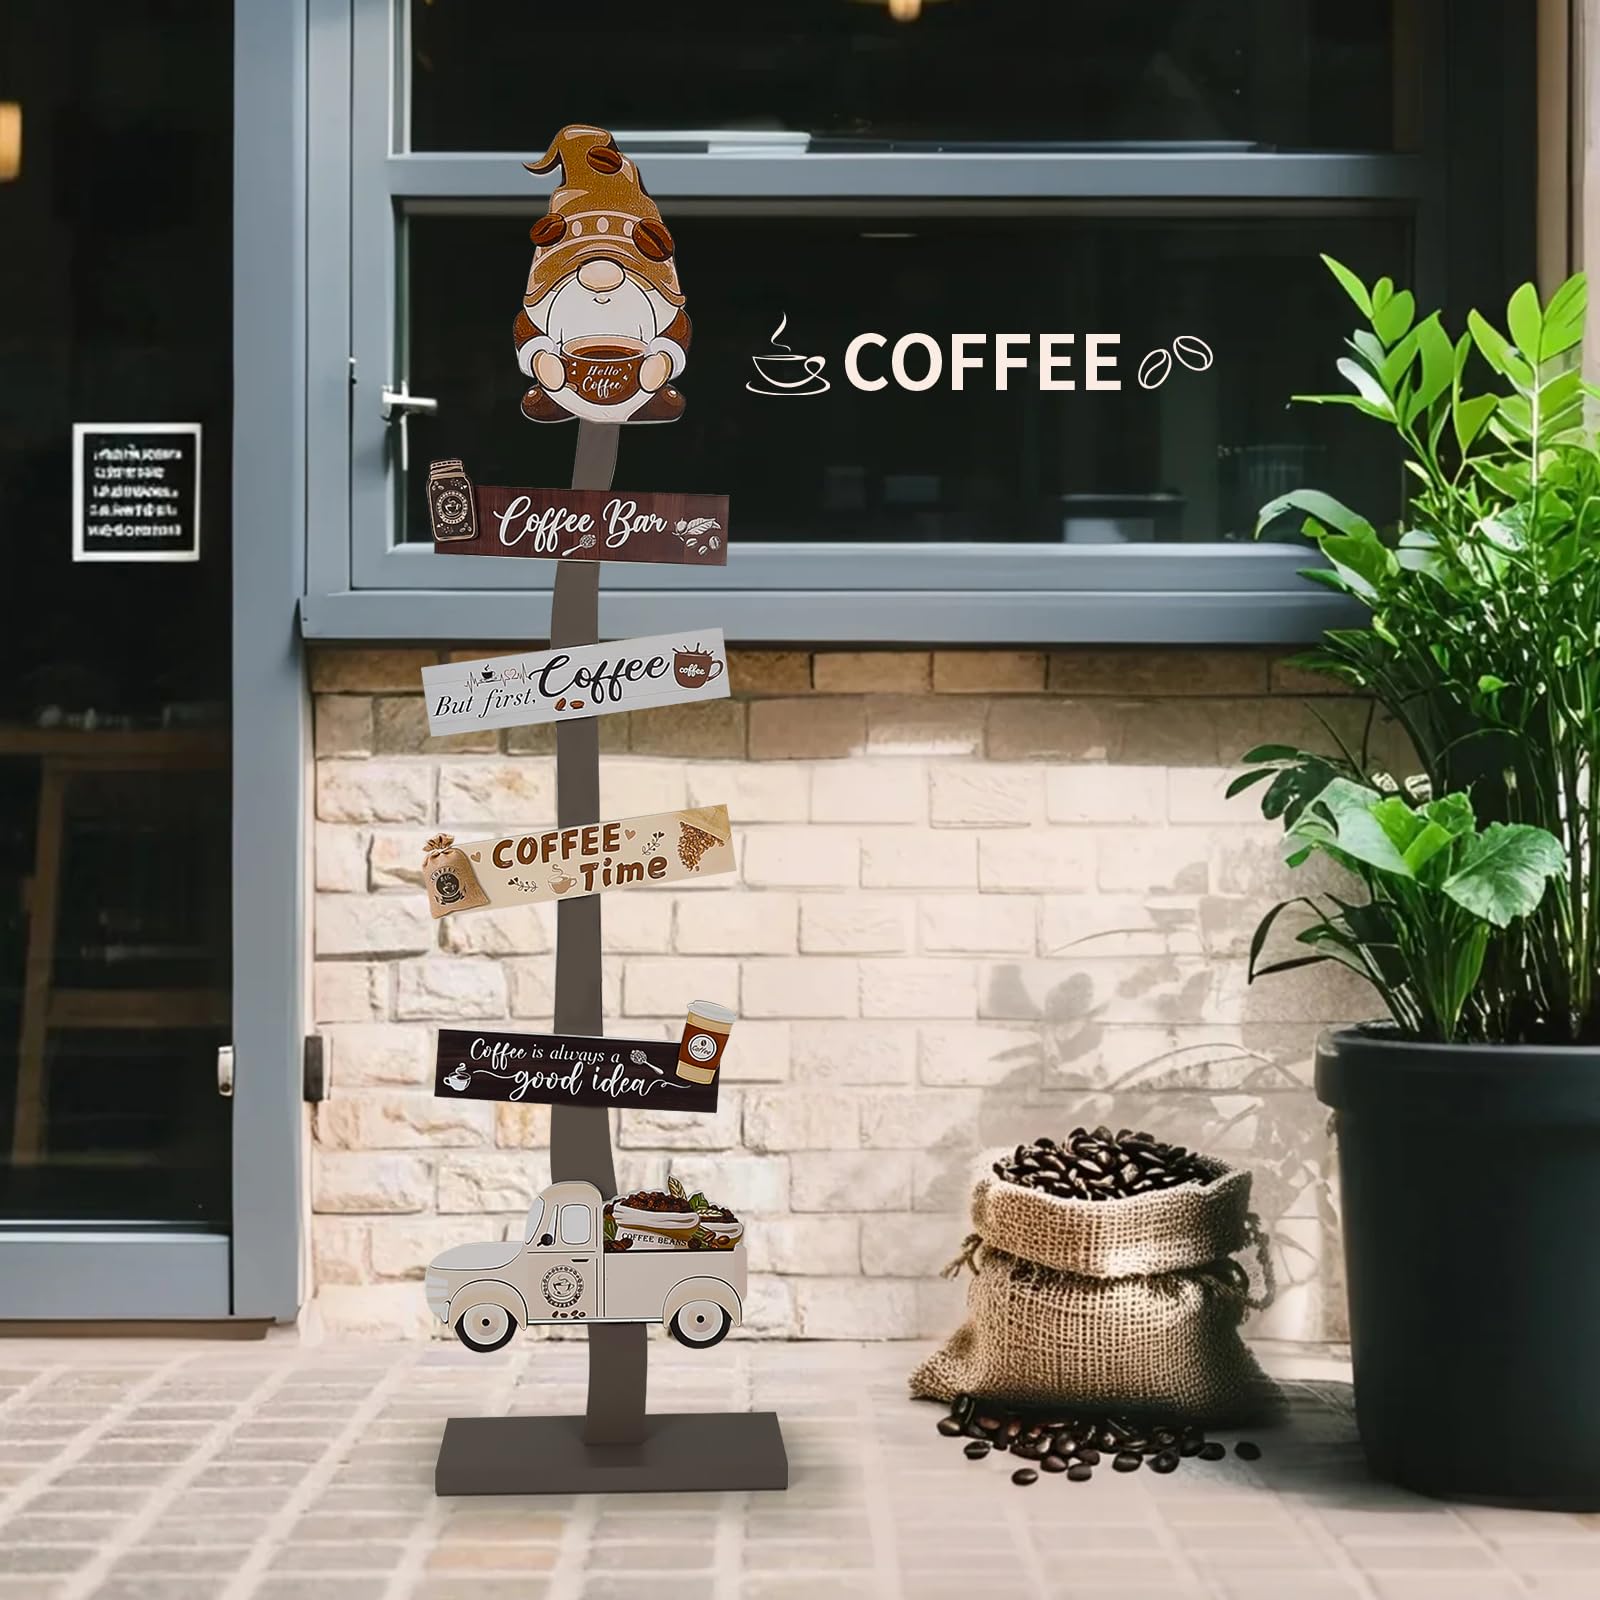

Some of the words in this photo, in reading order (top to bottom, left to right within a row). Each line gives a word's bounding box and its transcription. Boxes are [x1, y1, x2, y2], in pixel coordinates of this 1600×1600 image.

[587, 364, 623, 377] Hello
[844, 332, 1122, 392] COFFEE
[582, 376, 622, 399] Coffee
[493, 495, 596, 553] Coffee
[602, 498, 668, 549] Bar
[529, 654, 670, 705] Coffee
[678, 663, 706, 677] coffee
[433, 695, 474, 717] But
[492, 822, 622, 870] COFFEE
[580, 856, 668, 893] Time
[470, 1037, 528, 1070] Coffee
[532, 1043, 544, 1060] is
[549, 1045, 605, 1065] always
[610, 1053, 621, 1064] a
[509, 1062, 585, 1102] good
[592, 1063, 655, 1098] idea
[621, 1232, 655, 1244] COFFEE
[657, 1236, 688, 1247] BEANS
